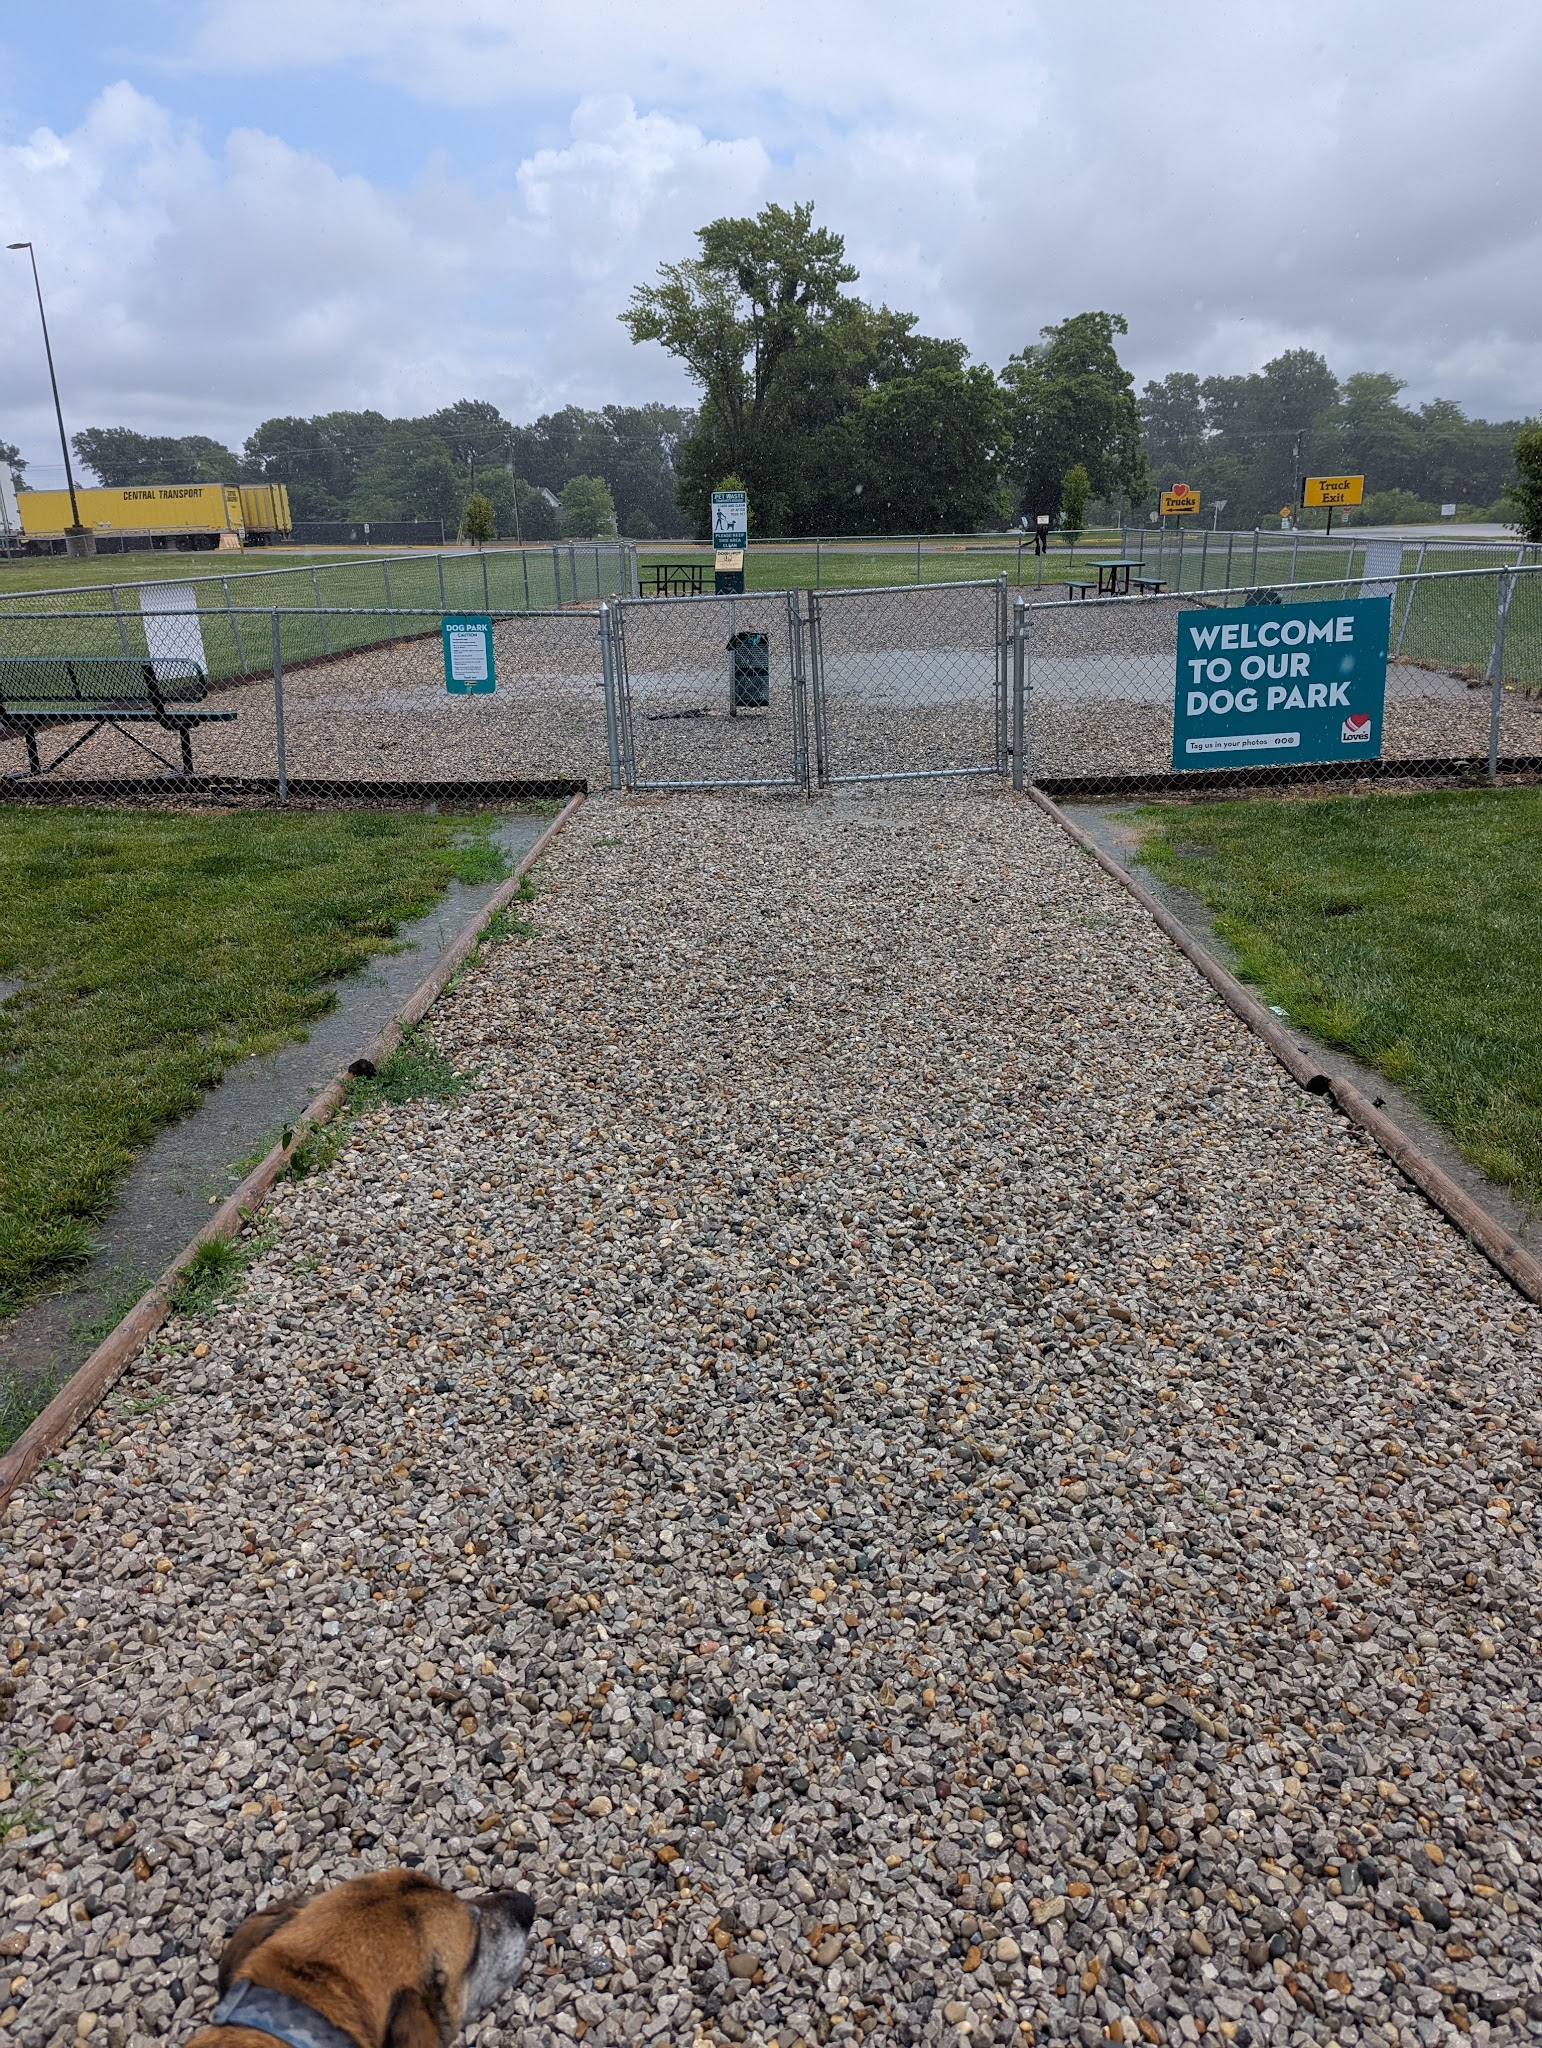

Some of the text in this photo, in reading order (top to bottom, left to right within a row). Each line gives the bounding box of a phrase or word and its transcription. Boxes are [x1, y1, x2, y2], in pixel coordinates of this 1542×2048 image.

[1319, 480, 1350, 490] Truck
[123, 488, 203, 501] CENTRAL TRANSPORT
[1322, 493, 1344, 502] Exit
[1166, 497, 1196, 506] Trucks
[1189, 616, 1355, 651] WELCOME
[1188, 652, 1311, 684] TO OUR
[1186, 681, 1351, 716] DOG PARK
[1343, 731, 1369, 741] Love's
[1190, 742, 1203, 751] Tag
[1224, 741, 1240, 749] your
[1242, 739, 1268, 748] photos
